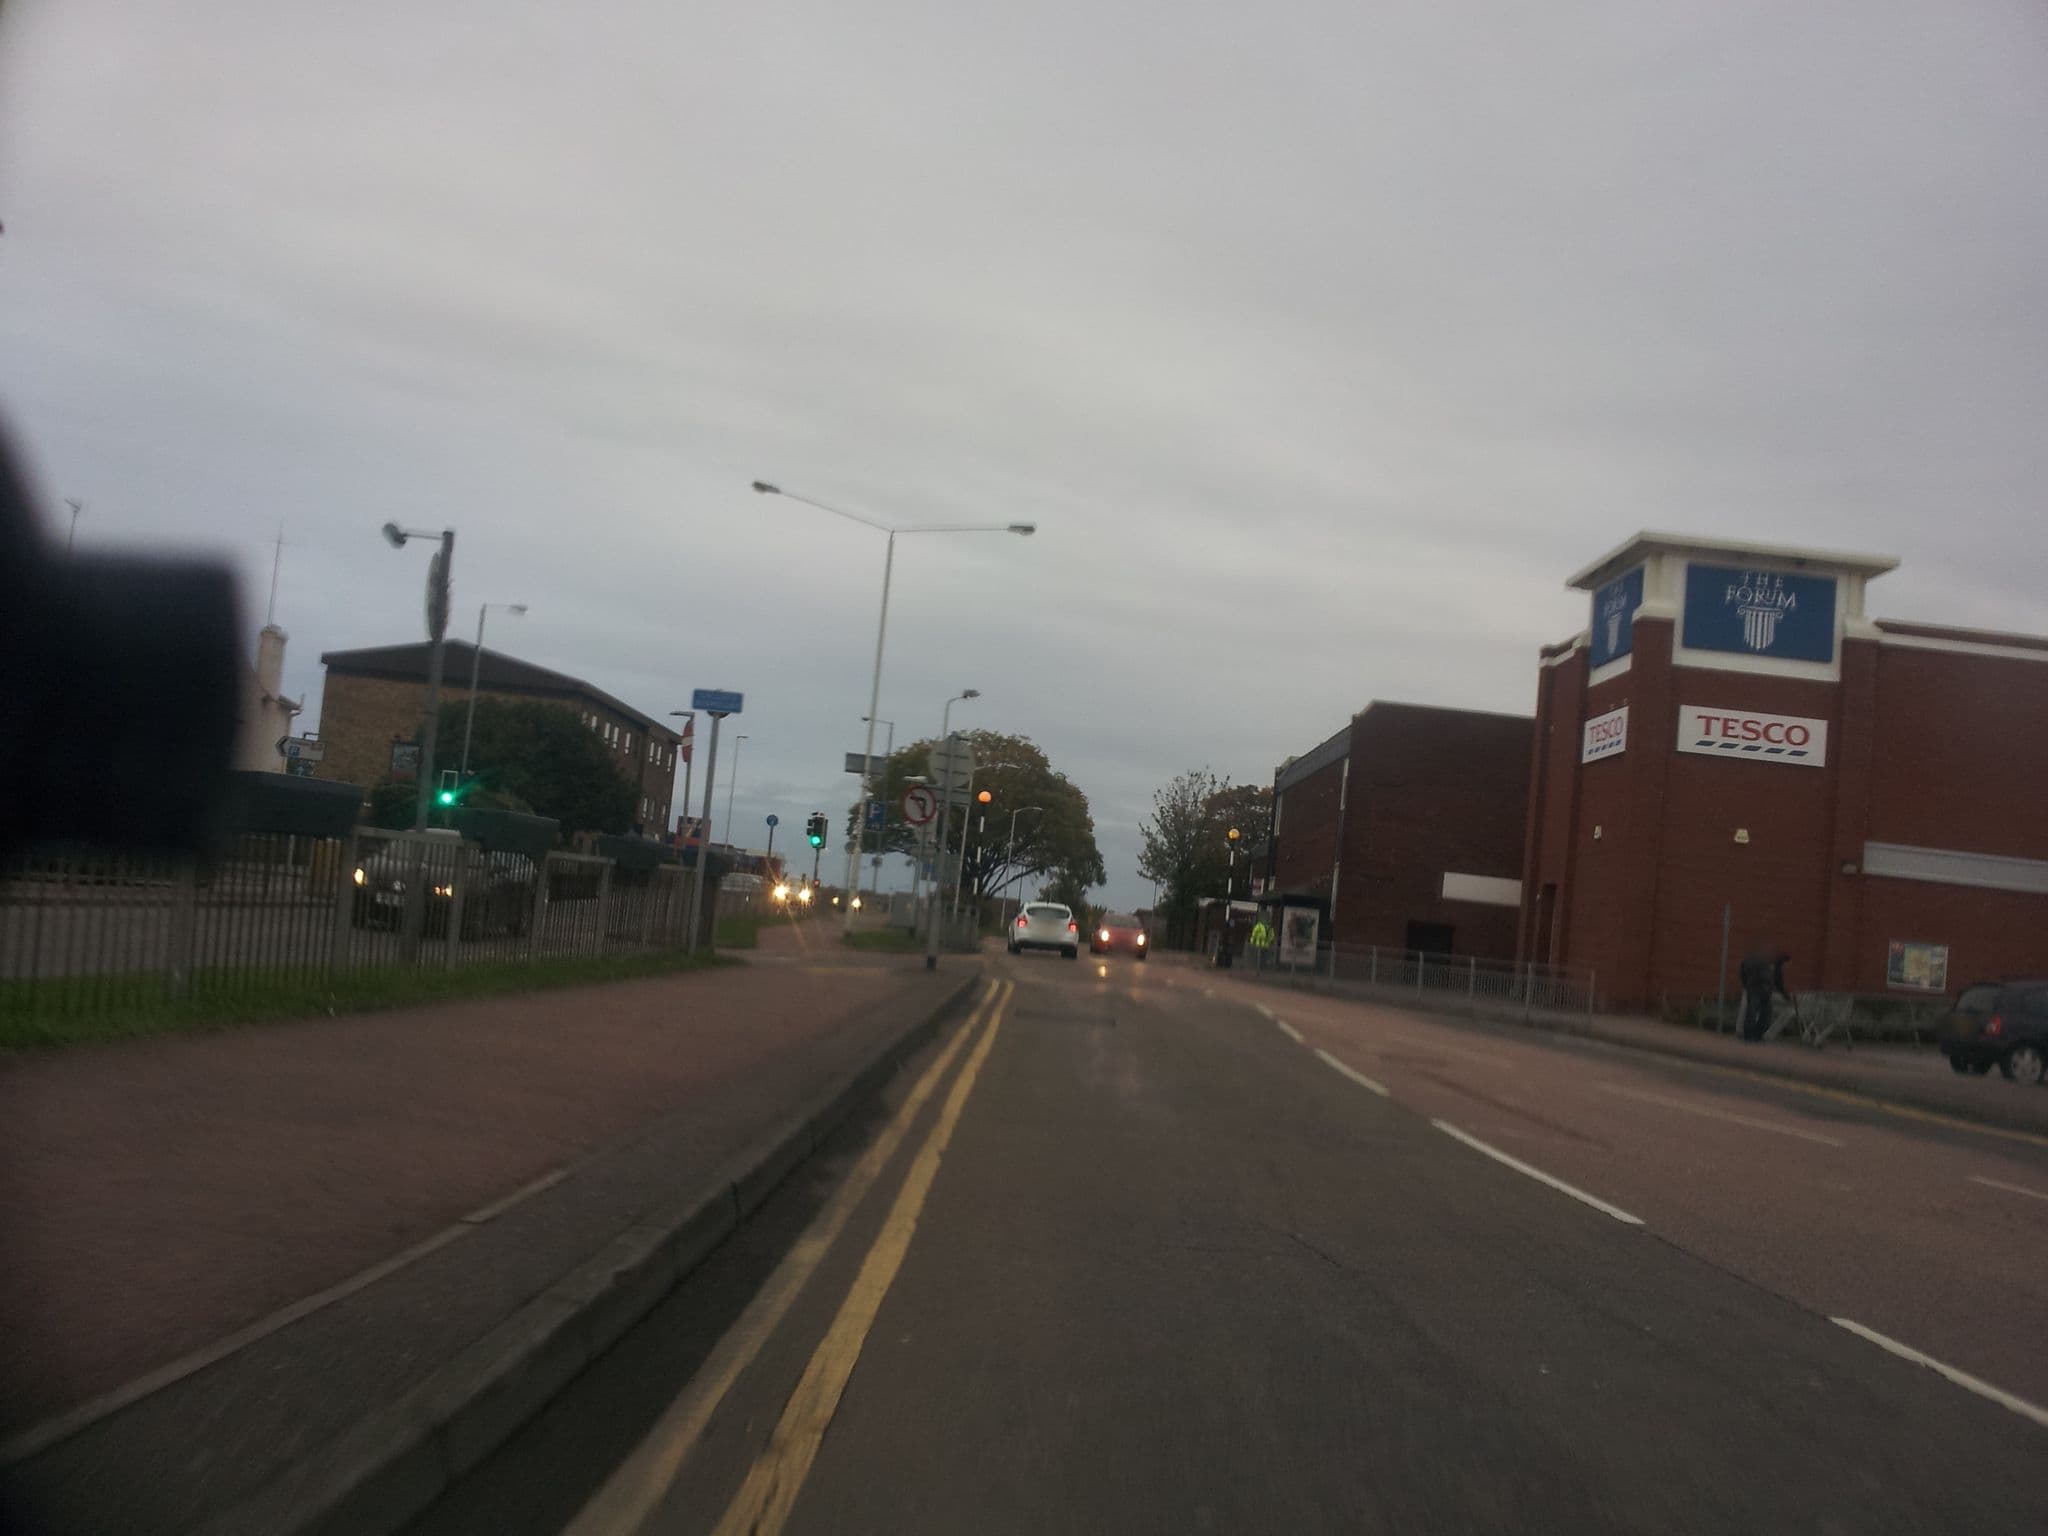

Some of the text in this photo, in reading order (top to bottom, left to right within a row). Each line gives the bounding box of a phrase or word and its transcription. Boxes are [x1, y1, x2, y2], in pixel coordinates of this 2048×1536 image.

[1725, 584, 1797, 609] FORUM
[1590, 716, 1624, 745] TESCO
[1696, 715, 1810, 747] TESCO
